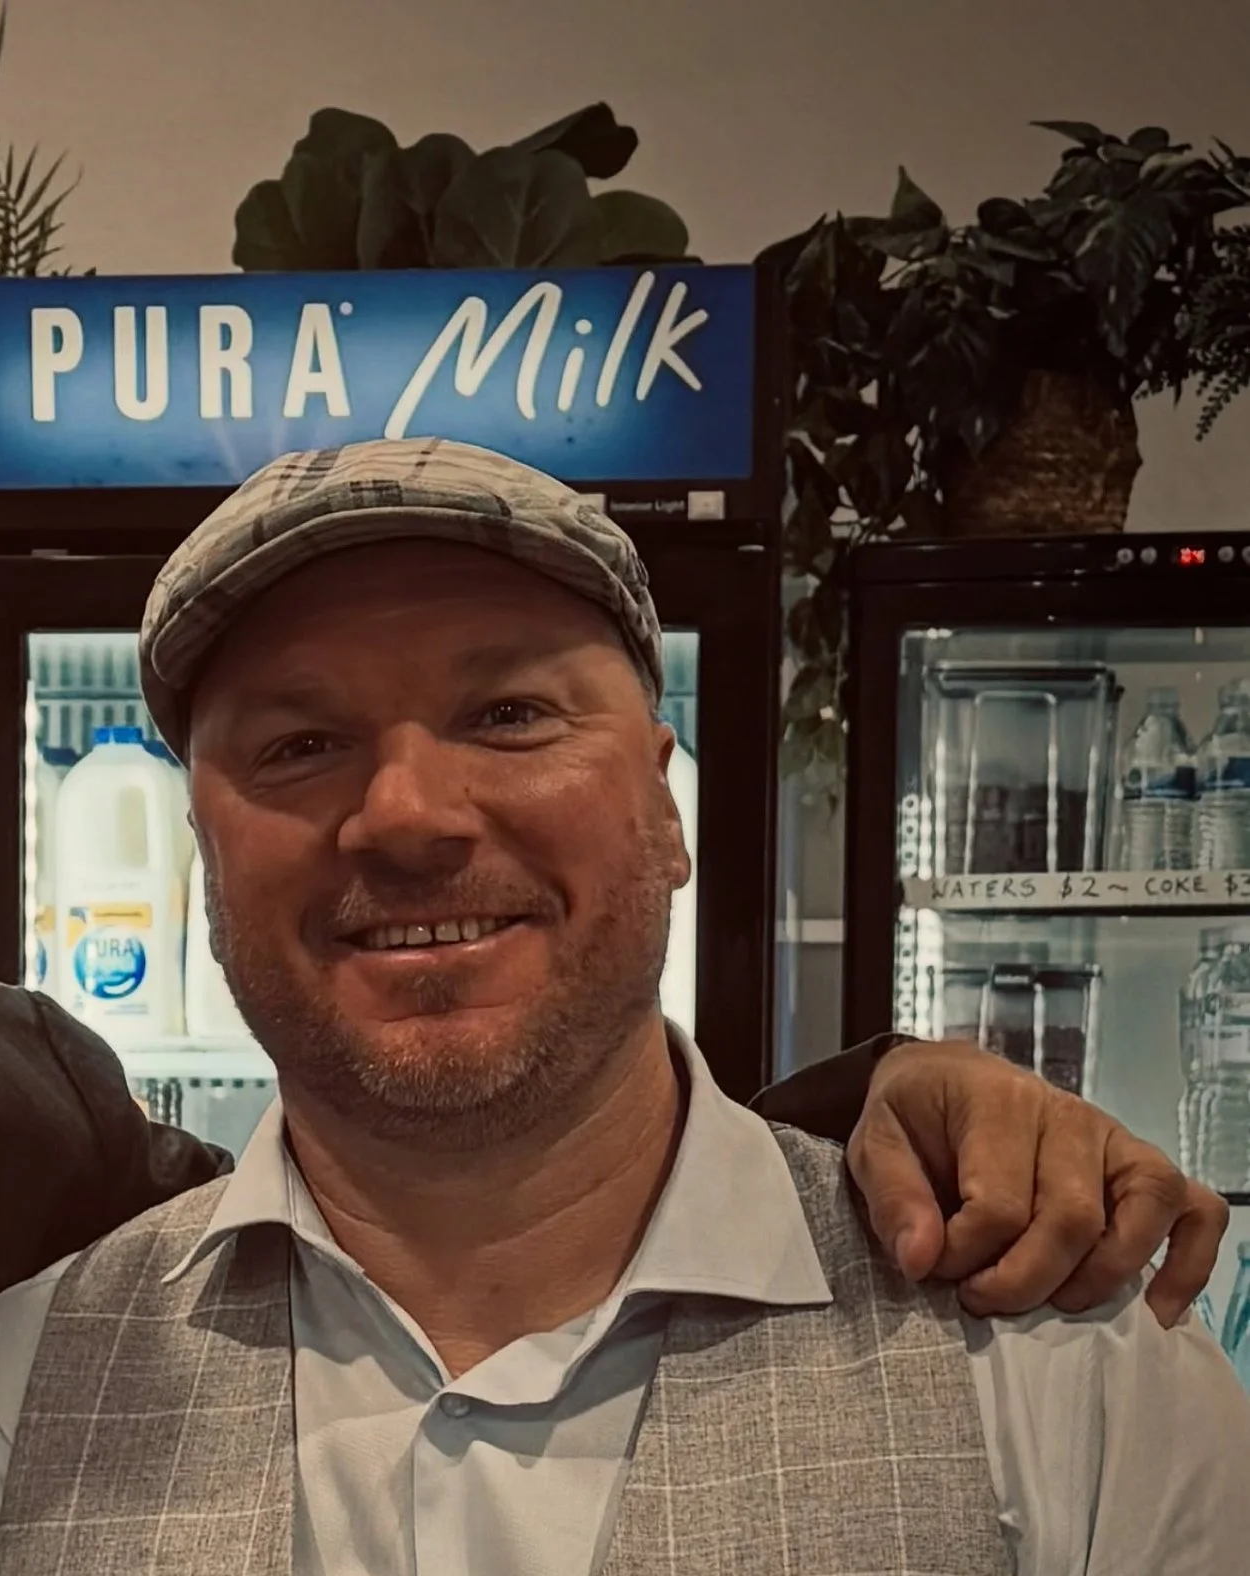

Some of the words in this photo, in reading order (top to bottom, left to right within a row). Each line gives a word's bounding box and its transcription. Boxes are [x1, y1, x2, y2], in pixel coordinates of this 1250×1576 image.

[30, 303, 351, 422] PURA
[384, 270, 709, 440] Milk
[931, 875, 1038, 899] WATERS
[1061, 875, 1100, 898] $2
[1145, 875, 1208, 895] COKE
